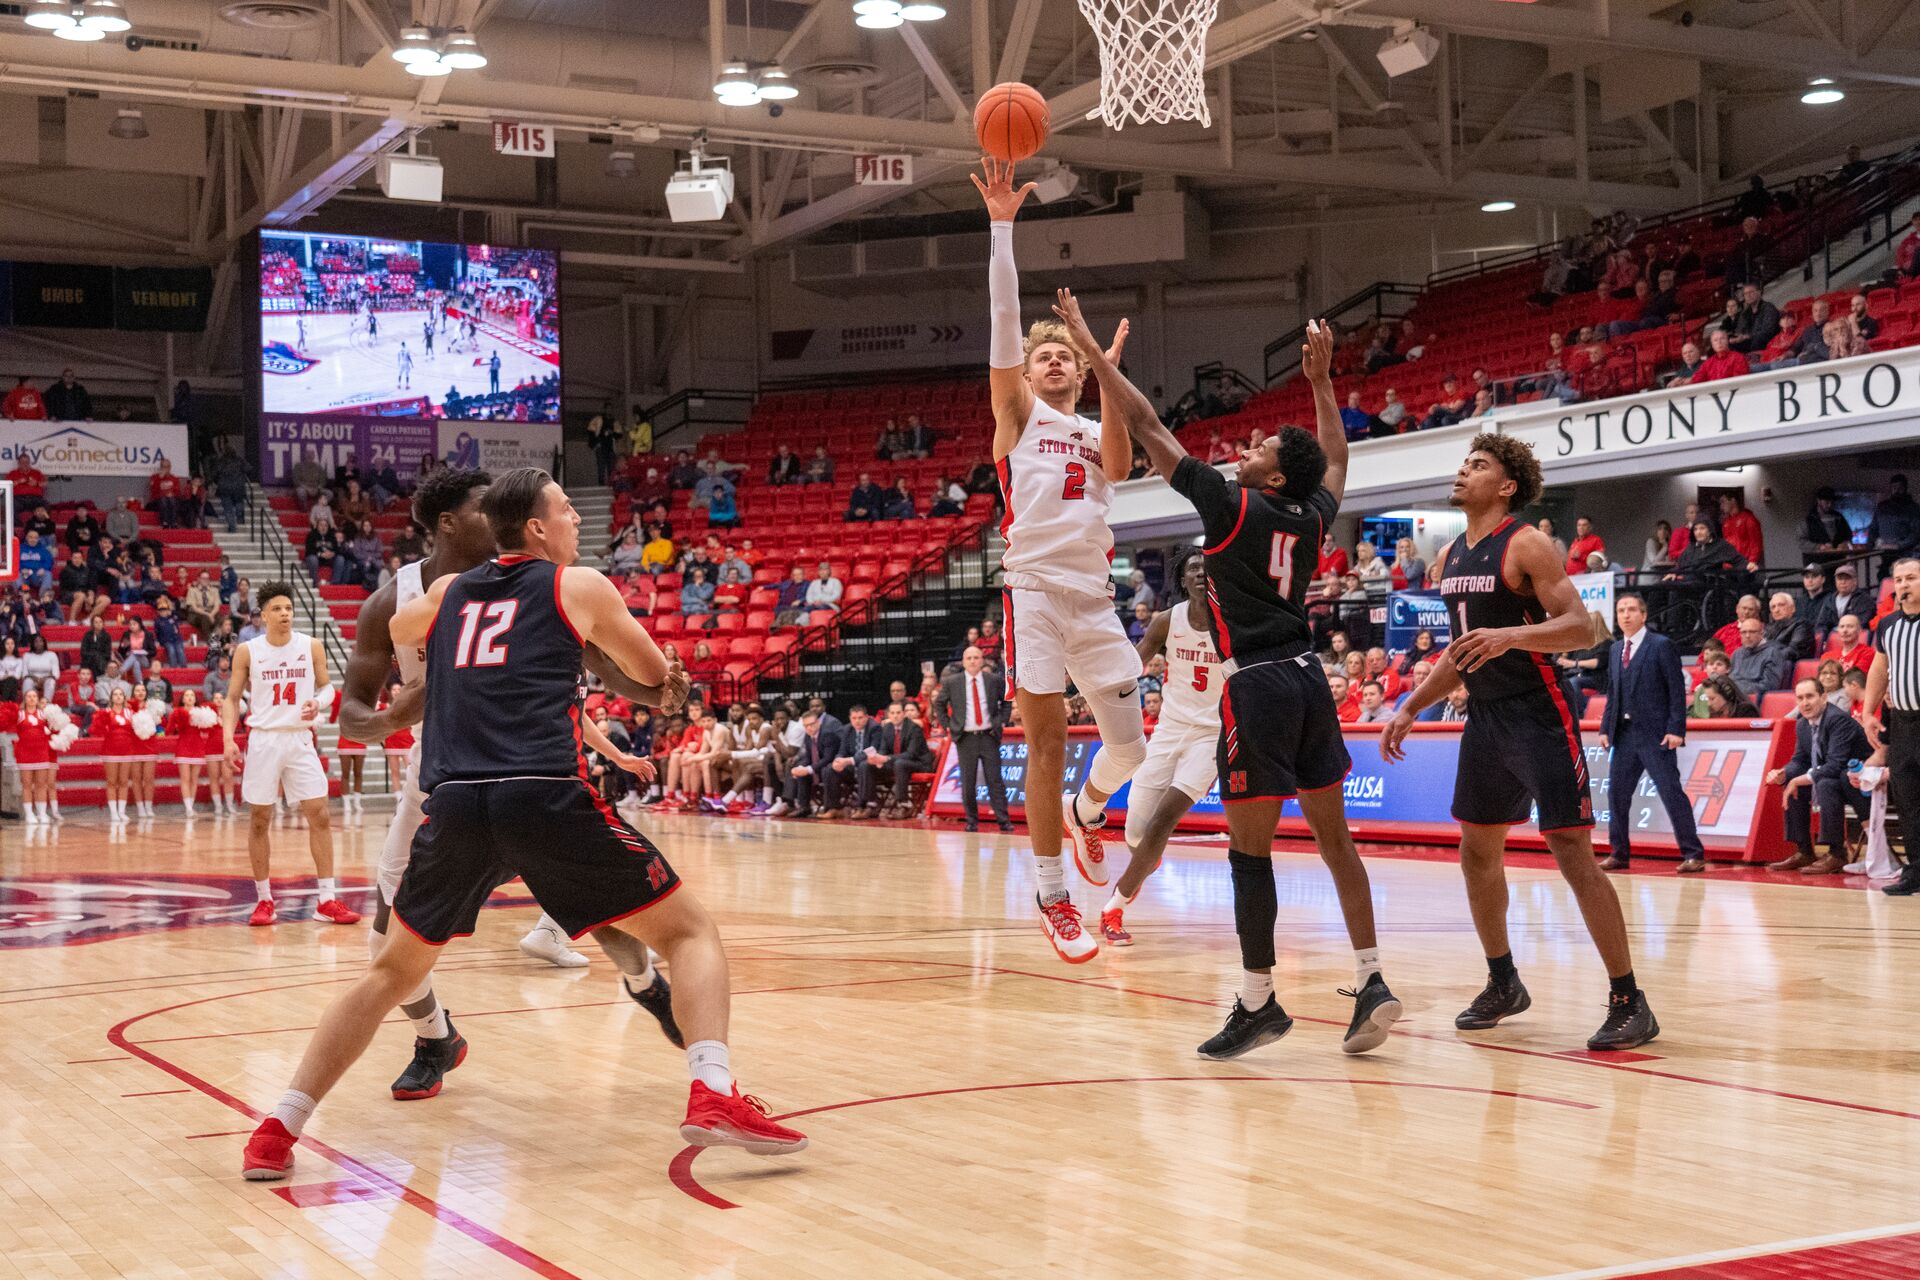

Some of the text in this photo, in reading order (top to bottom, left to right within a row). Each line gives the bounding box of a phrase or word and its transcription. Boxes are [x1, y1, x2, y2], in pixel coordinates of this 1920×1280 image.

[511, 127, 546, 152] 115
[870, 159, 904, 181] 116
[41, 287, 84, 303] UMBC
[131, 290, 198, 307] VERMONT
[1557, 363, 1920, 456] STONY BRO
[267, 421, 298, 439] IT'S
[301, 423, 354, 440] ABOUT
[370, 425, 431, 435] CANCER PATIENTS
[370, 444, 397, 465] 24
[484, 448, 518, 457] CANCER
[530, 450, 554, 459] BLOO
[1039, 439, 1104, 469] STONY BRO
[1062, 461, 1086, 500] 2
[1268, 530, 1300, 600] 4
[1457, 600, 1469, 634] 1
[455, 597, 519, 669] 12
[1176, 647, 1221, 664] STONY BRO
[262, 668, 307, 681] STONY BROOK
[1191, 665, 1209, 692] 5
[272, 682, 297, 706] 14
[1074, 744, 1083, 759] 3
[1064, 766, 1077, 782] 14
[1639, 776, 1658, 796] 12
[1638, 808, 1652, 828] 2
